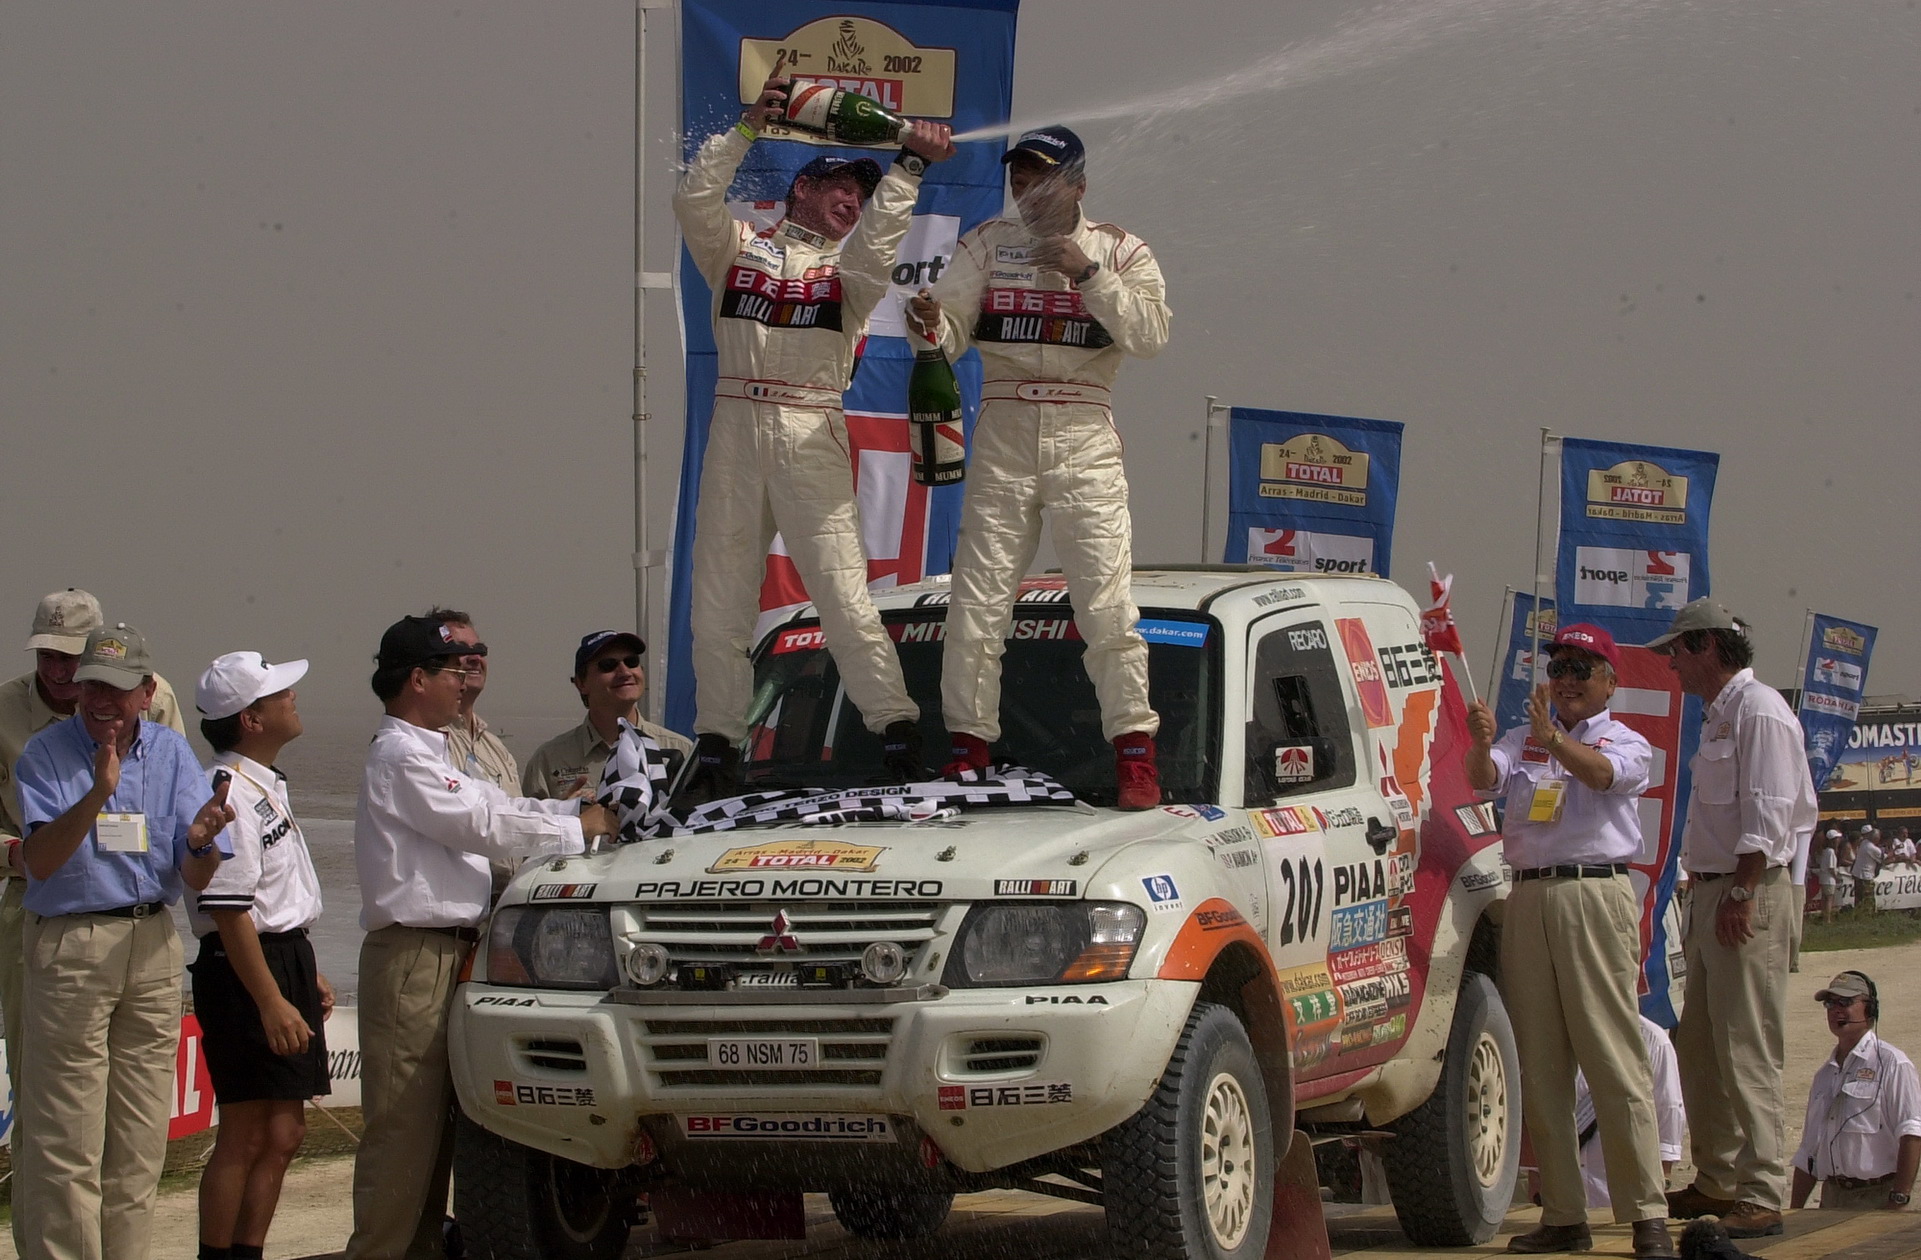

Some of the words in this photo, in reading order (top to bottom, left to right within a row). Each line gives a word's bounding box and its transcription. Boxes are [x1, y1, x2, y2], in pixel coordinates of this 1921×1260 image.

[884, 55, 922, 73] 2002
[796, 77, 898, 110] TAL
[891, 255, 945, 286] ort
[993, 290, 1082, 313] 日石三
[935, 468, 962, 481] MUMM
[1288, 463, 1341, 483] TOTAL
[1261, 486, 1286, 496] Arras
[1295, 488, 1329, 500] Madrid
[1338, 493, 1364, 504] Dakar
[1315, 557, 1367, 573] sport
[1288, 628, 1328, 652] RECARO
[845, 786, 912, 798] DESIGN
[757, 855, 831, 866] TOTAL
[636, 880, 765, 899] PAJERO
[772, 879, 943, 897] MONTERO
[1155, 878, 1169, 900] hp
[1333, 859, 1386, 906] PIAA
[1279, 854, 1324, 948] 201
[1383, 973, 1410, 998] HKS
[474, 996, 537, 1008] PIAA
[1025, 995, 1109, 1005] PIAA
[719, 1043, 739, 1065] 68
[746, 1043, 783, 1065] NSM
[789, 1043, 809, 1064] 75
[516, 1086, 598, 1107] 日石三菱
[970, 1083, 1072, 1107] 日石三菱
[687, 1116, 887, 1133] BFGoodrich
